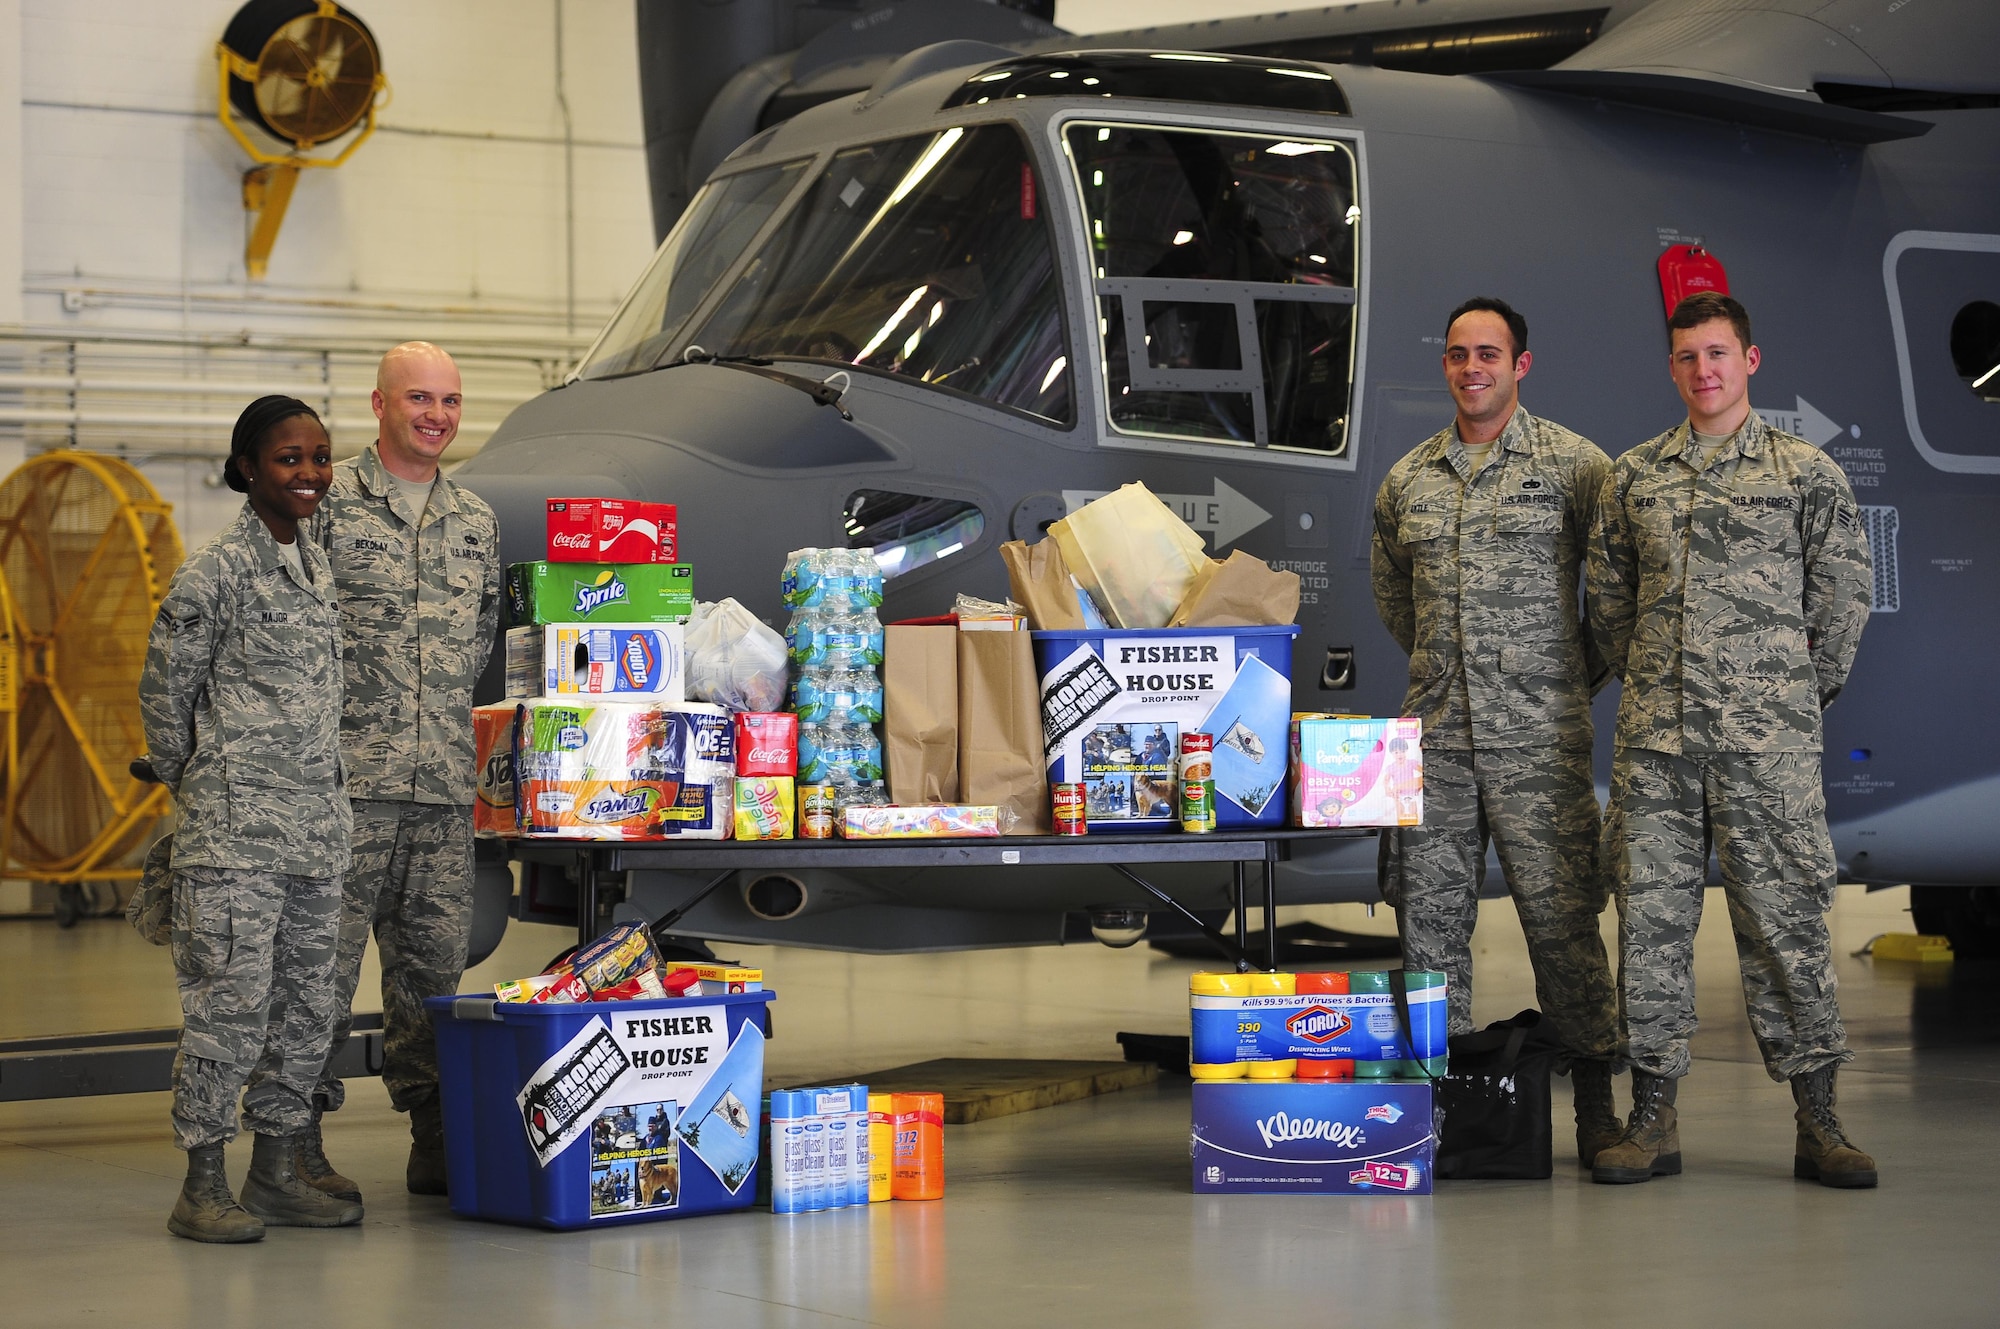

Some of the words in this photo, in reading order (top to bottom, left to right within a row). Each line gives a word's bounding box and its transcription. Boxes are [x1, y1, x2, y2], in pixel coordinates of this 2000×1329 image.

[1834, 447, 1884, 459] CARTRIDGE
[1501, 497, 1514, 505] U.S.
[1516, 495, 1531, 505] AIR
[1533, 494, 1559, 505] FORCE
[1733, 496, 1746, 505] U.S.
[1750, 496, 1765, 506] AIR
[1767, 497, 1793, 508] FORCE
[450, 547, 460, 558] U.S.
[462, 549, 472, 559] AIR
[1265, 560, 1327, 573] ARTRIDGE
[1300, 577, 1329, 589] ATED
[576, 578, 625, 612] Sprite
[261, 611, 288, 623] MAJOR
[627, 638, 648, 684] CLOROX
[1120, 645, 1219, 664] FISHER
[1045, 661, 1106, 717] HOME
[1126, 674, 1214, 691] HOUSE
[1075, 675, 1116, 714] HOME
[1170, 694, 1200, 702] POINT
[1054, 701, 1078, 724] AWAY
[1059, 710, 1083, 731] FROM
[720, 747, 731, 756] 15
[1316, 748, 1360, 765] Pampers
[1091, 764, 1120, 772] HELPING
[1122, 764, 1149, 772] HEROES
[1307, 777, 1337, 787] easy
[1338, 776, 1361, 787] ups
[587, 792, 649, 819] Towels
[741, 789, 771, 836] mello
[699, 970, 717, 978] BARS!
[1242, 998, 1262, 1007] Kills
[1264, 998, 1293, 1006] 99.9%
[1295, 996, 1305, 1005] of
[1355, 995, 1395, 1004] Bacteria
[626, 1016, 713, 1039] FISHER
[1236, 1022, 1262, 1033] 390
[1292, 1011, 1345, 1037] CLOROX
[631, 1047, 709, 1069] HOUSE
[554, 1035, 617, 1099] HOME
[587, 1050, 626, 1093] HOME
[641, 1072, 663, 1081] DROP
[665, 1069, 693, 1079] POINT
[566, 1081, 590, 1106] AWAY
[571, 1089, 595, 1114] FROM
[543, 1091, 568, 1126] FISHER
[548, 1086, 574, 1119] HOUSE
[895, 1131, 917, 1144] 312
[1256, 1111, 1360, 1149] Kleenex
[598, 1151, 627, 1161] HELPING
[627, 1148, 652, 1158] HEROES
[653, 1146, 668, 1155] HEAL
[785, 1141, 801, 1158] glass
[805, 1139, 821, 1156] glass
[829, 1136, 844, 1154] glass
[1207, 1166, 1220, 1177] 12
[1374, 1166, 1391, 1180] 12
